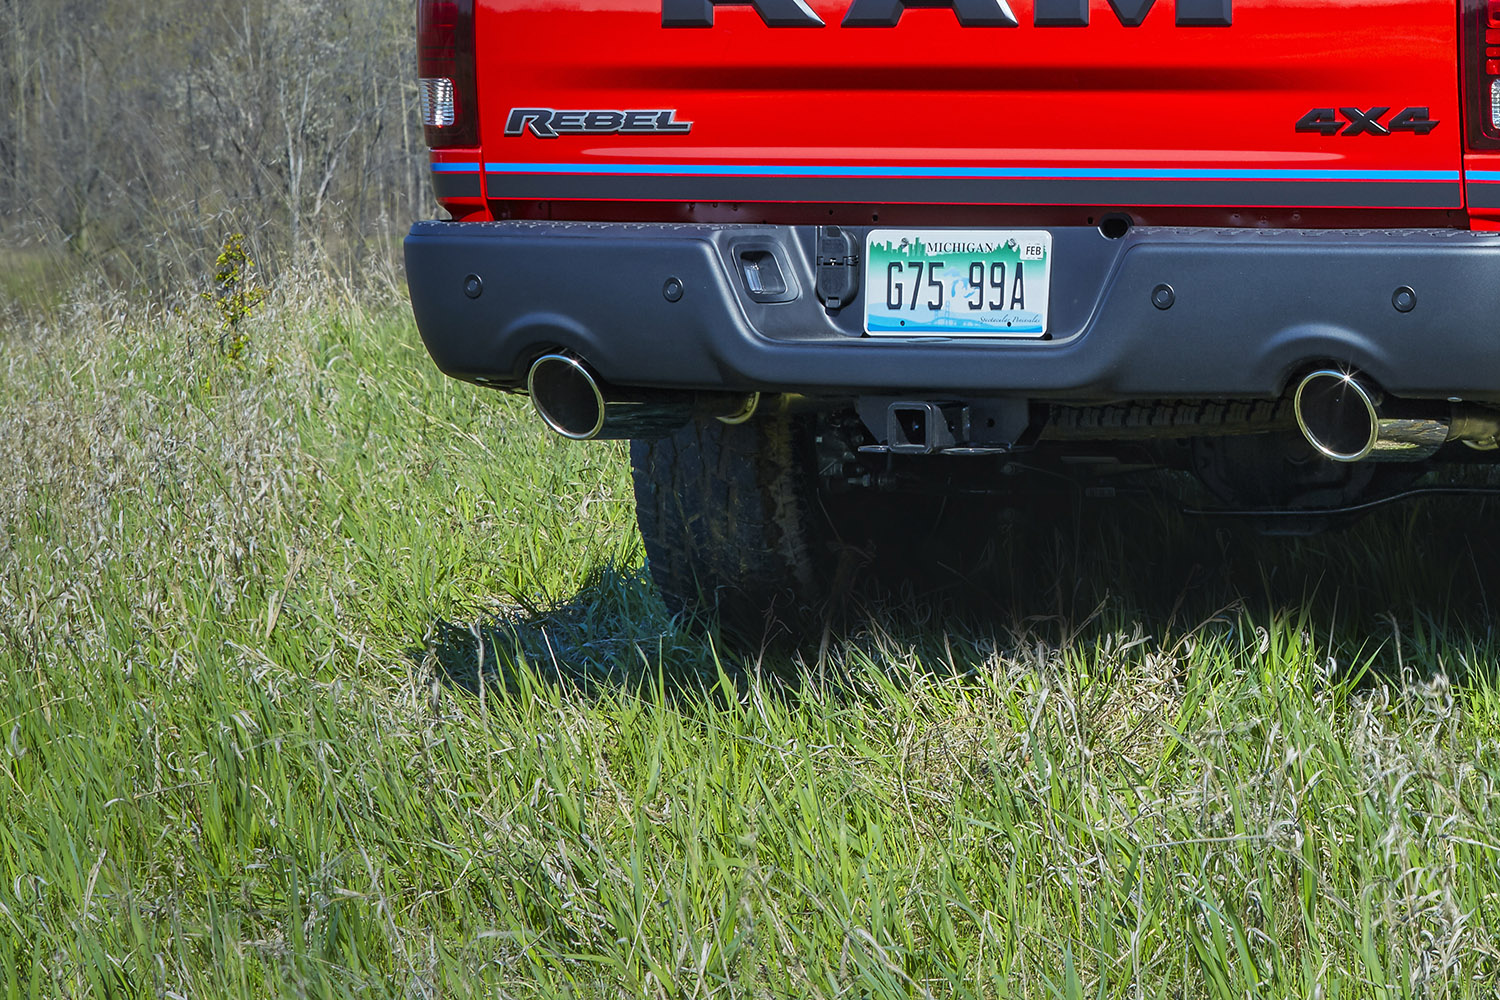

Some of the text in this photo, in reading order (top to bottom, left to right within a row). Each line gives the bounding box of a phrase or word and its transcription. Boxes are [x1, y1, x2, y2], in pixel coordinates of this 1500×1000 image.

[504, 107, 694, 138] REBEL
[927, 242, 995, 254] MICHIGAN
[1025, 245, 1043, 256] FEB
[886, 261, 1026, 311] G75 99A
